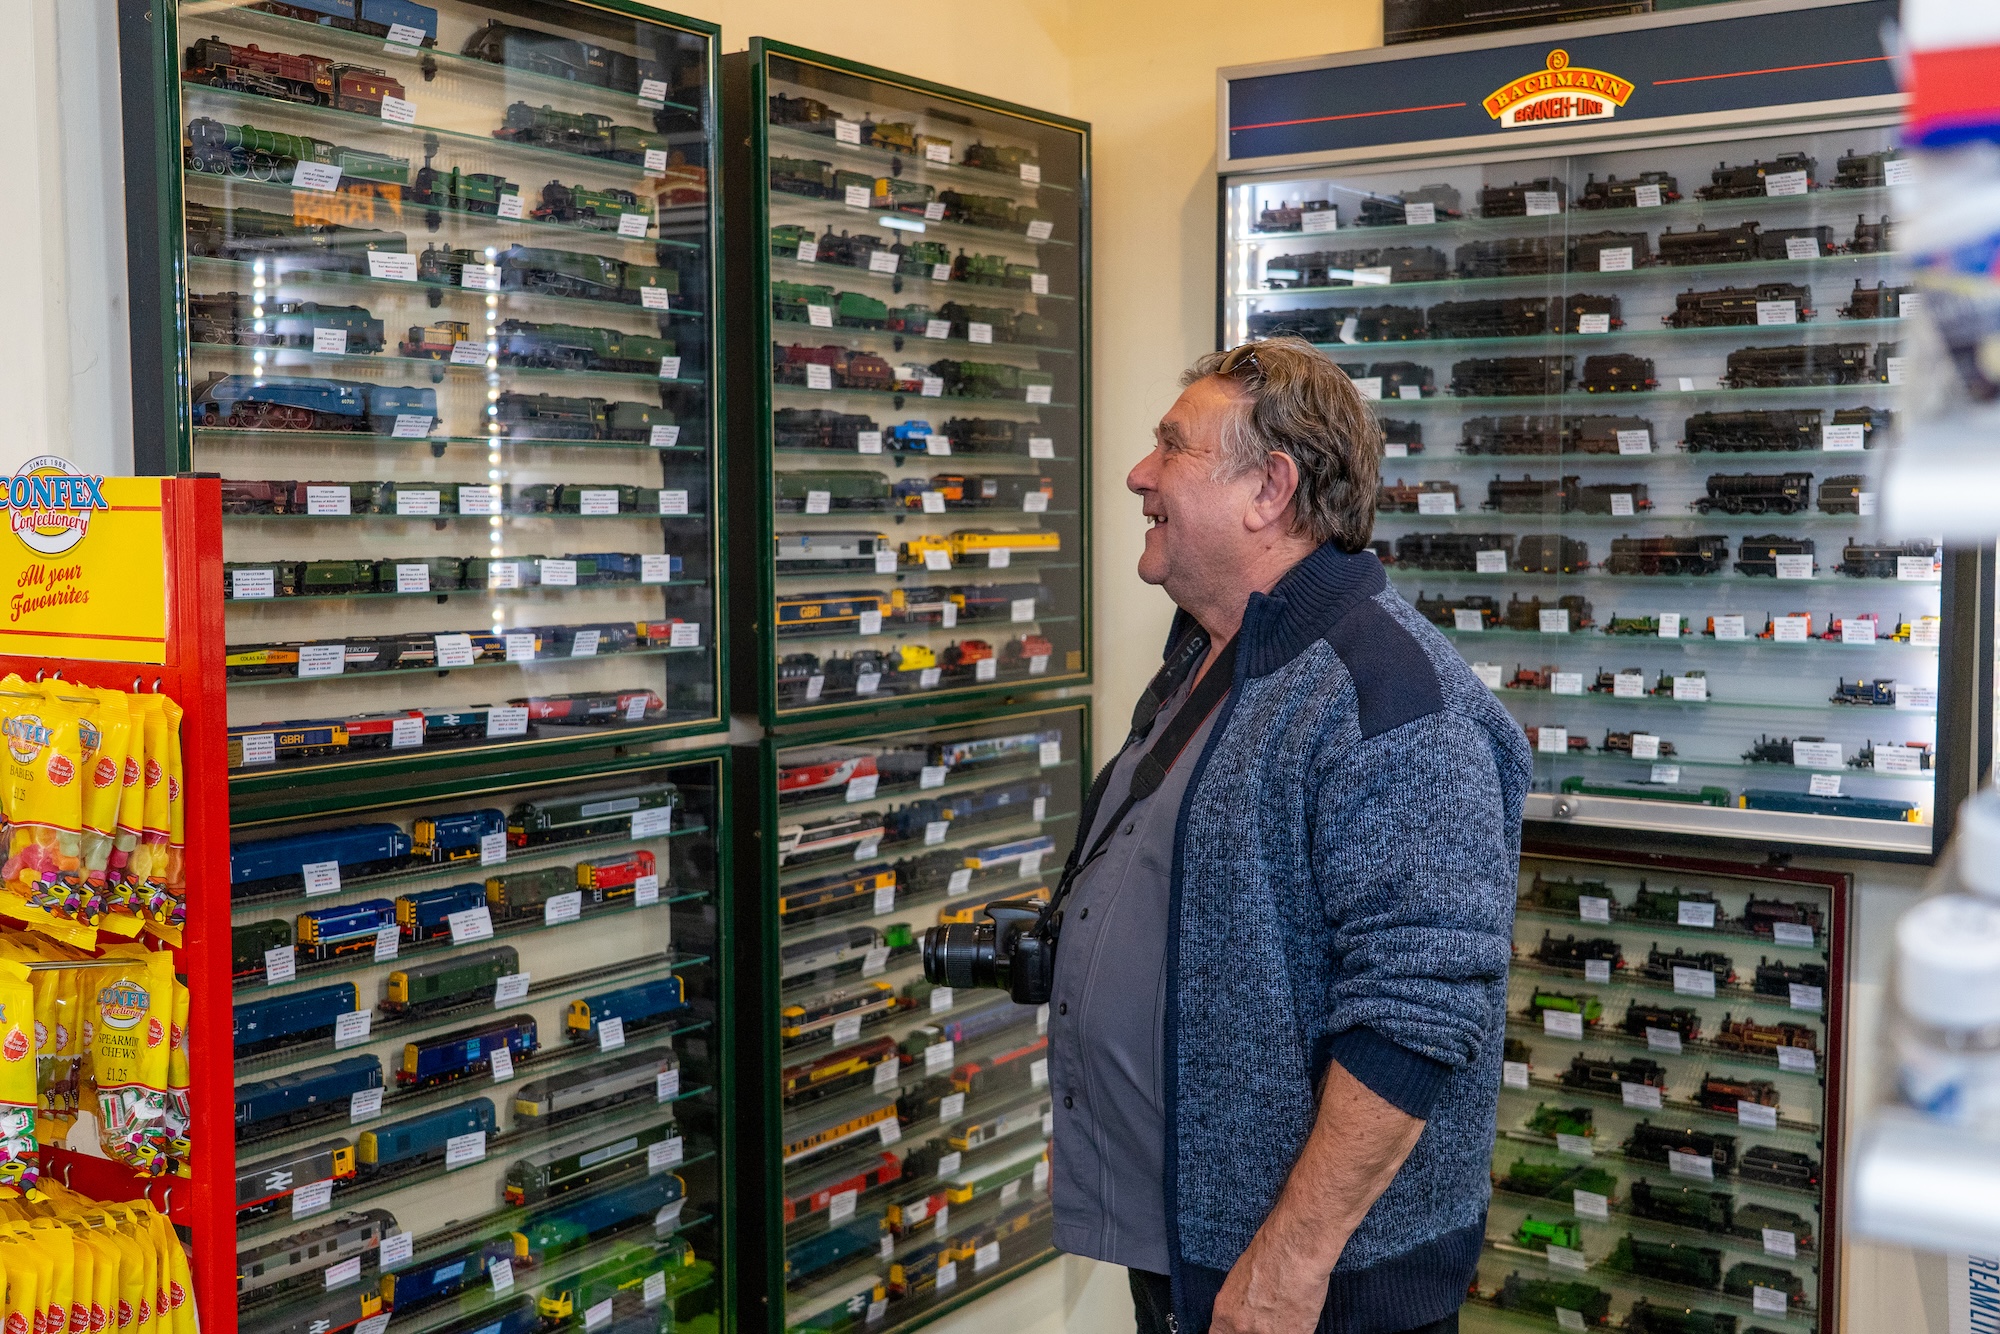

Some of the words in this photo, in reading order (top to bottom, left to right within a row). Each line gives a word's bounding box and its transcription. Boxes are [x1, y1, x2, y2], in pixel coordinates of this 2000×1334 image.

[1494, 72, 1625, 109] BACHMANN
[1514, 96, 1604, 124] BRANCH-LINE
[29, 458, 47, 471] SINCE
[0, 475, 106, 508] CONFEX
[11, 510, 88, 536] Confectionery
[17, 564, 46, 588] All
[45, 564, 83, 592] your
[10, 584, 90, 622] Favourites
[279, 733, 305, 745] GBRf
[10, 764, 34, 782] BABIES
[101, 1045, 137, 1060] CHEWS
[106, 1067, 128, 1083] £1.25
